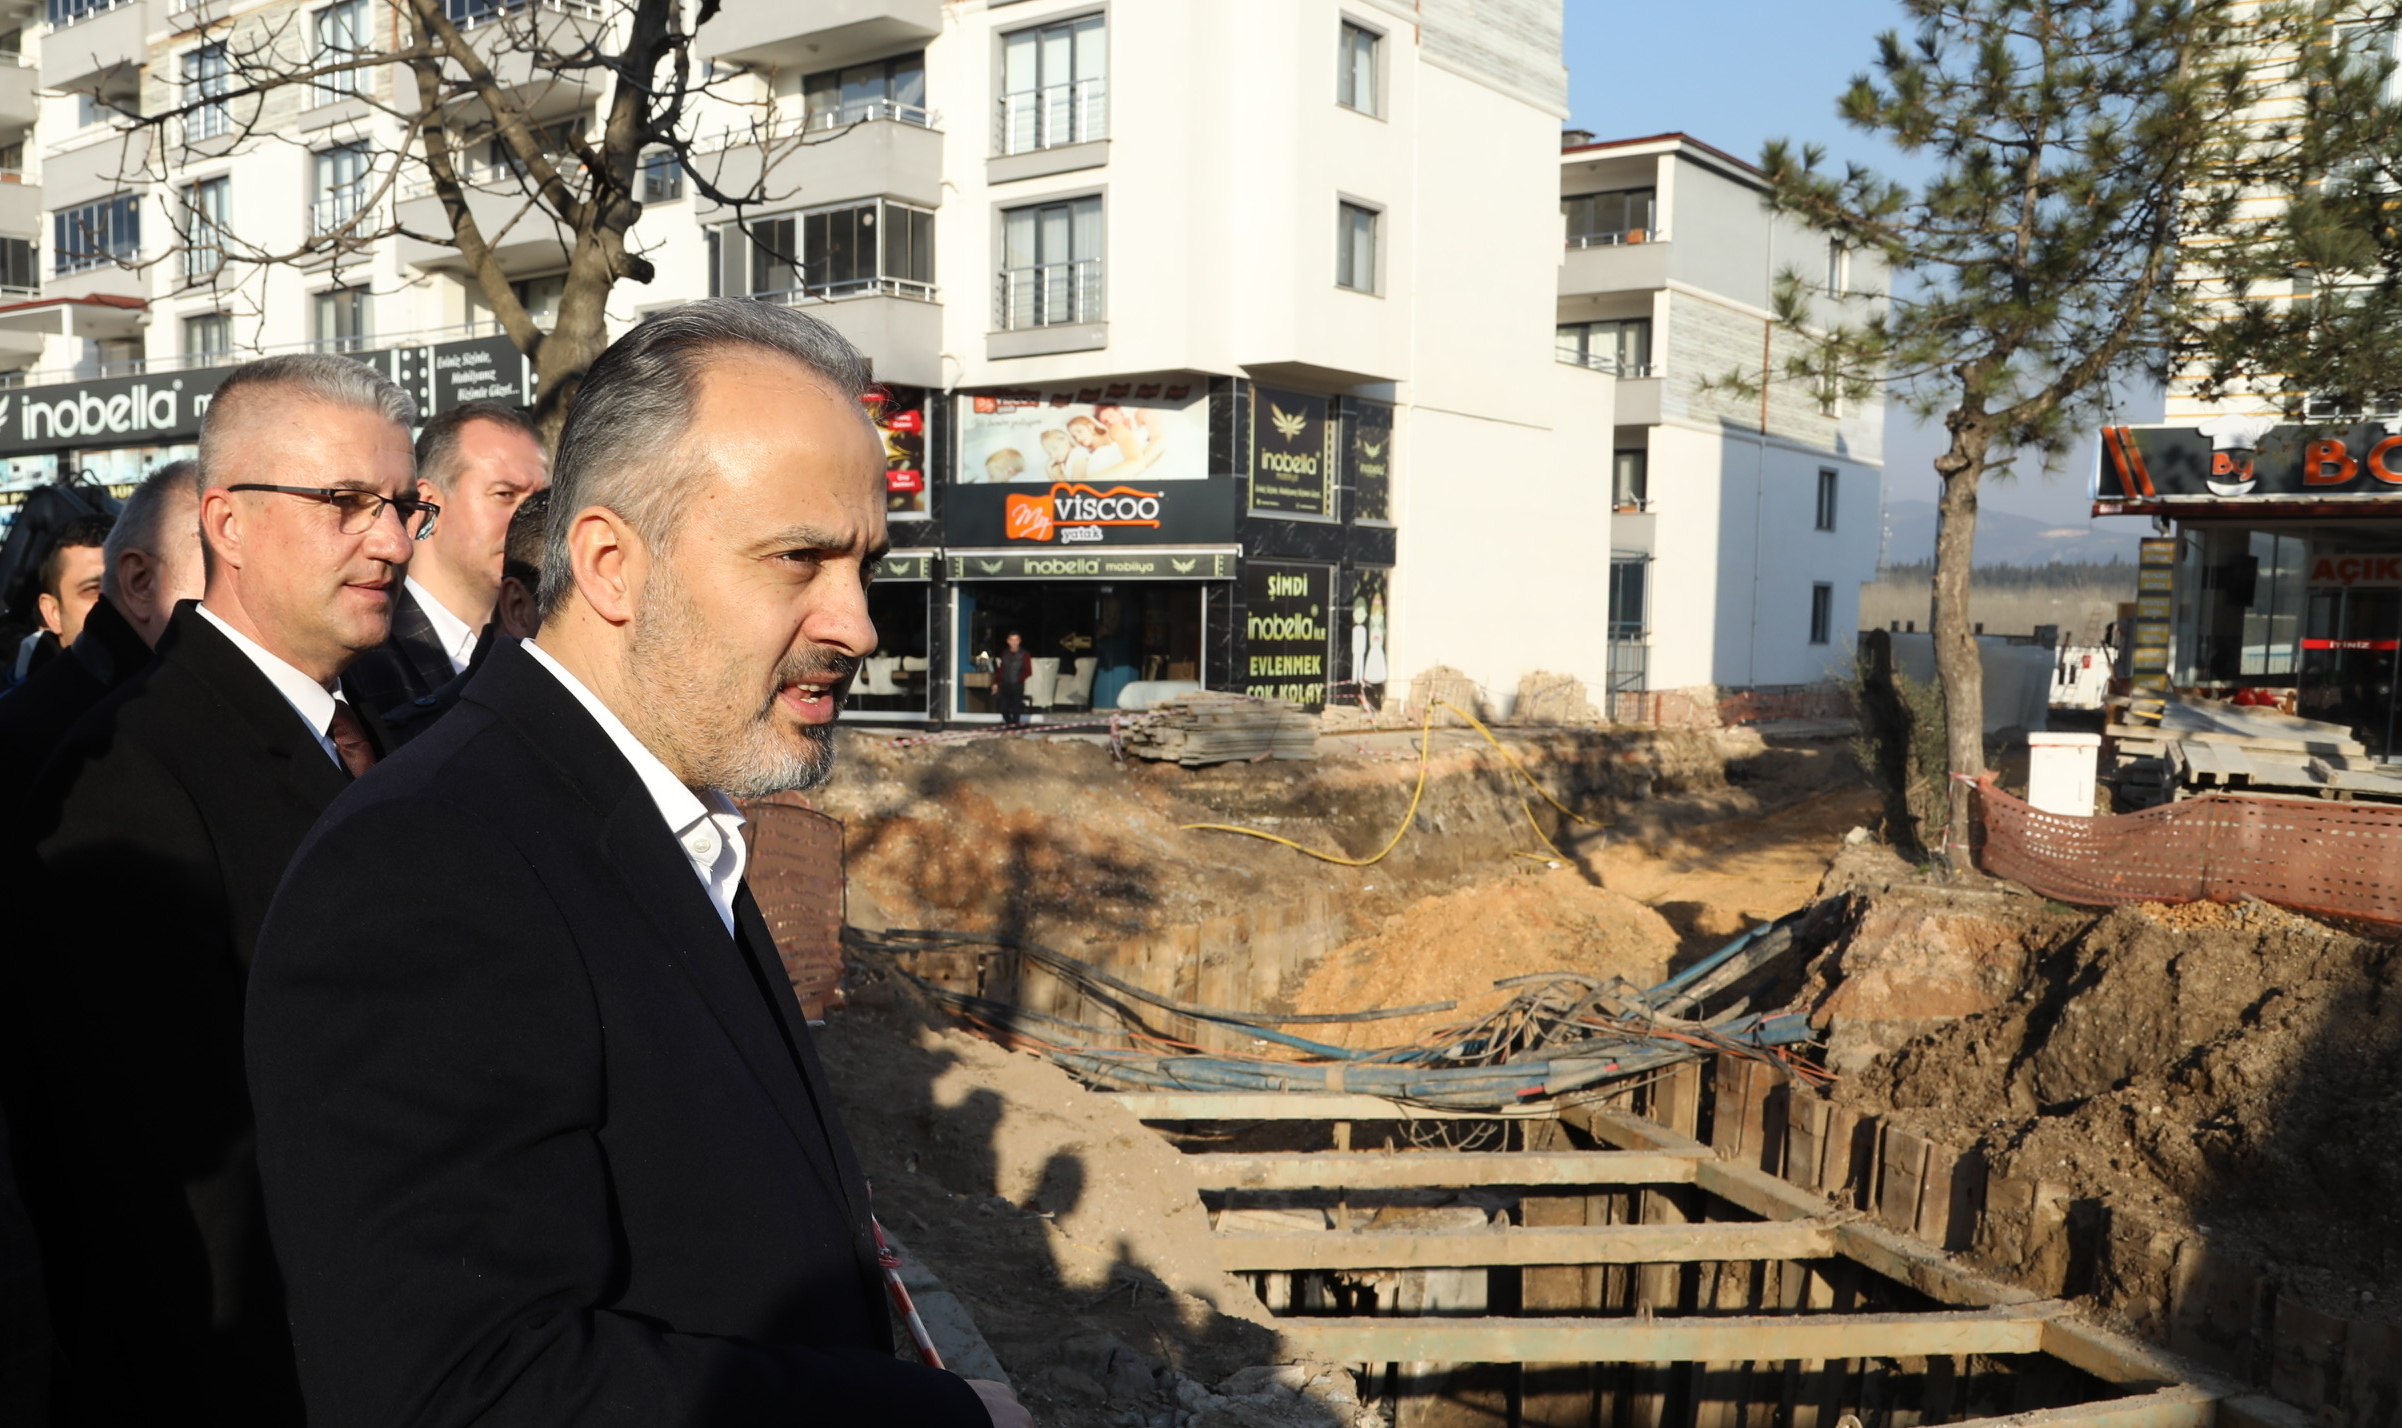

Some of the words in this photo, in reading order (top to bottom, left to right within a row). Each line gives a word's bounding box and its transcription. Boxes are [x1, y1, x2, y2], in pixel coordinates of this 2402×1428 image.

[2212, 452, 2254, 482] By
[1061, 525, 1103, 544] yatak
[1105, 561, 1154, 574] mobilya
[1268, 572, 1309, 601] ŞİMDİ
[1250, 655, 1321, 676] EVLENMEK
